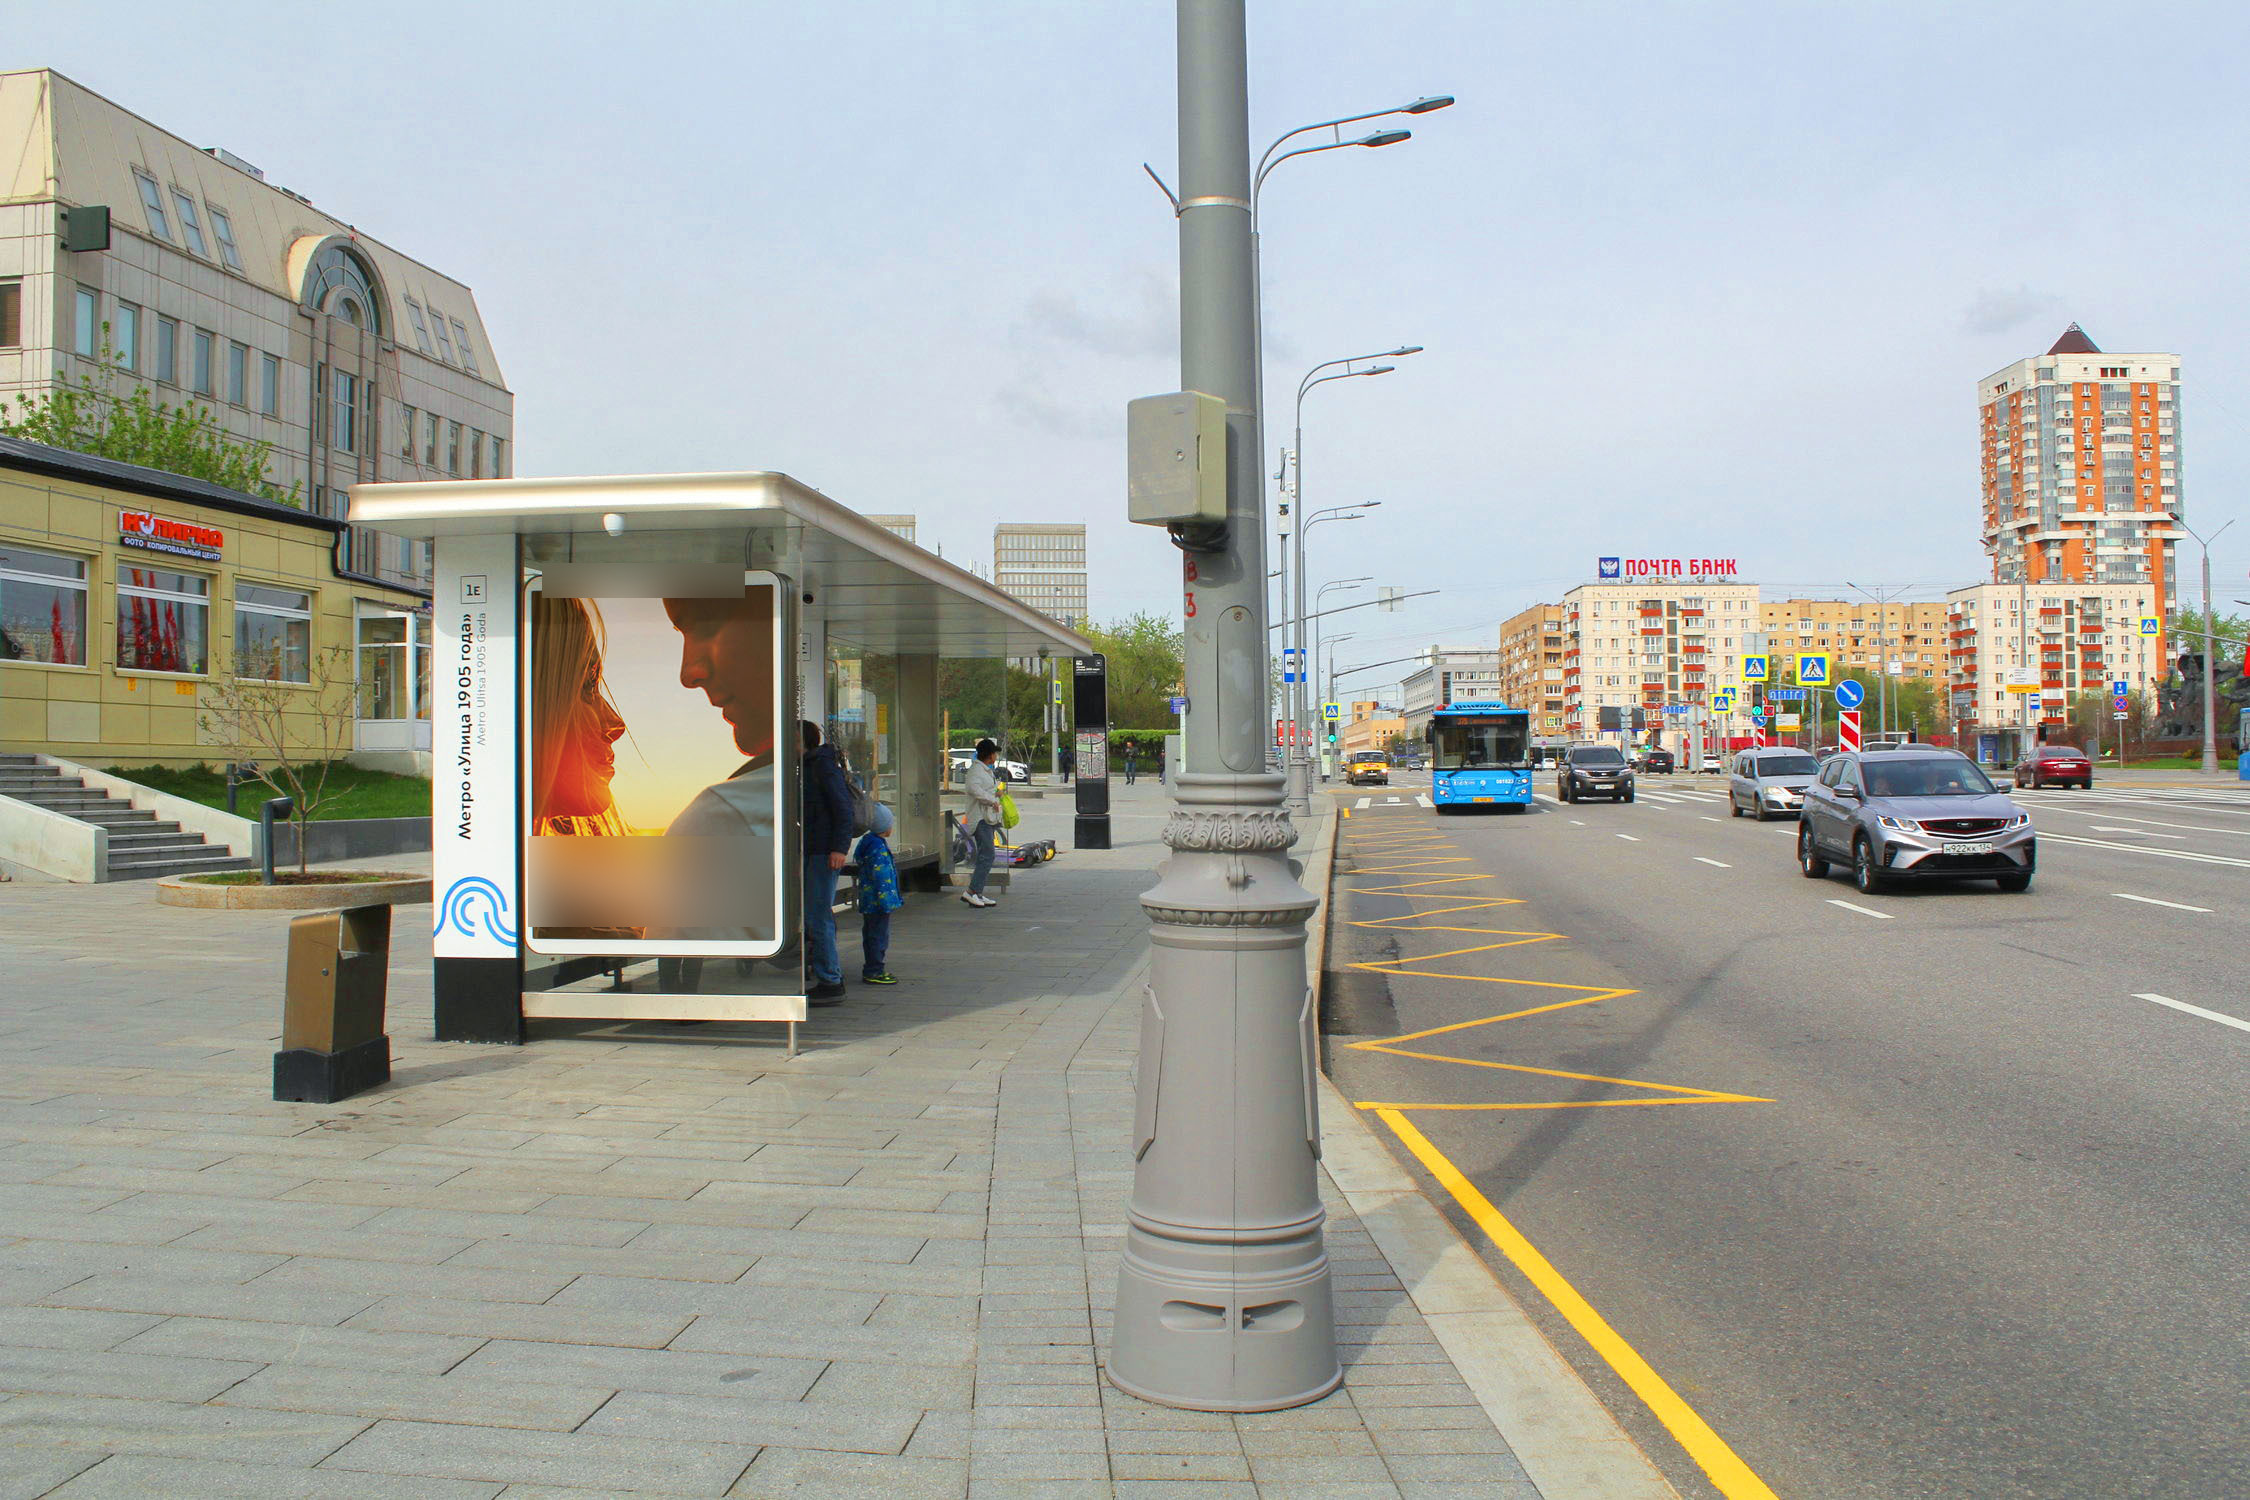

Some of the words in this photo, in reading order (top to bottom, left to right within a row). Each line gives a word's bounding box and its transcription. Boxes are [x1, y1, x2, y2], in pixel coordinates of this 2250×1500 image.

[124, 536, 145, 548] ФОТО
[146, 540, 201, 558] КОПИРОВАЛЬНЫЙ
[201, 550, 221, 561] ЦЕНТР
[1625, 558, 1683, 576] ПОЧТА
[1689, 558, 1738, 576] БАНК
[461, 613, 473, 661] года»
[476, 612, 487, 643] Goda
[476, 645, 487, 674] 1905
[457, 665, 472, 709] 1905
[476, 677, 487, 708] Ulitsa
[458, 713, 473, 776] «Улица
[476, 711, 487, 746] Metro
[458, 780, 474, 841] Метро
